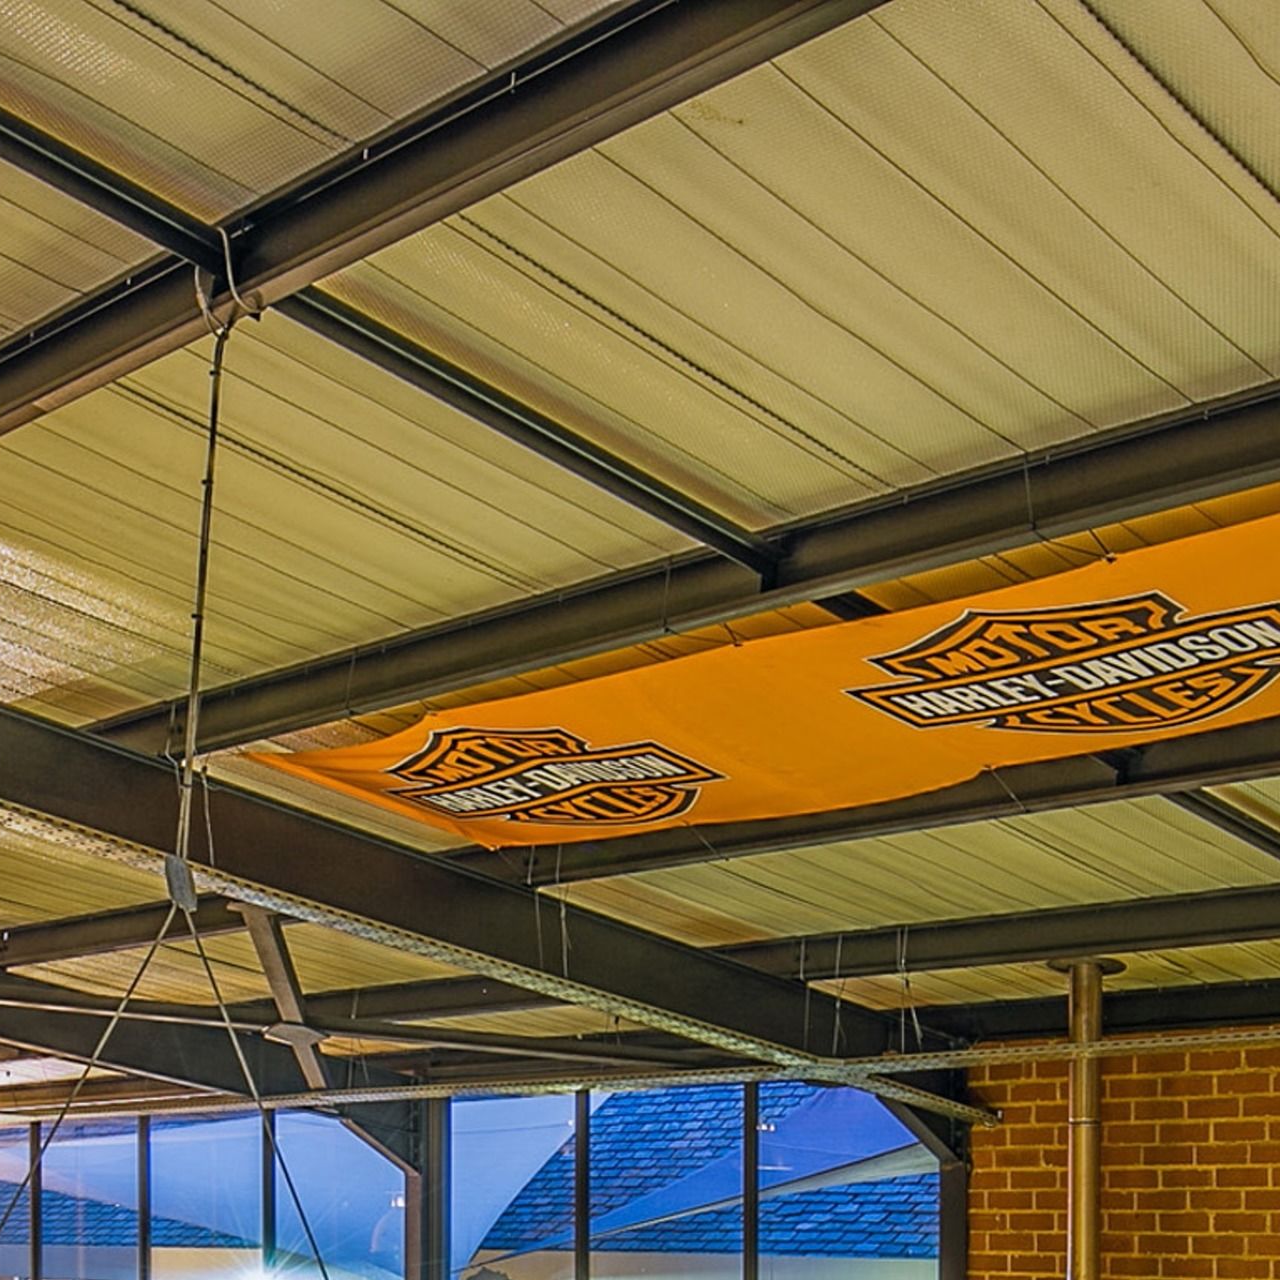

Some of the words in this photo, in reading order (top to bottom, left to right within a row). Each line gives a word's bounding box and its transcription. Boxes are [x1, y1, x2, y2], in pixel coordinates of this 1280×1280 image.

[930, 616, 1145, 678] MOTOR
[1030, 672, 1235, 726] CYCLES
[421, 754, 687, 812] HARLEY-DAVIDSON
[435, 736, 567, 784] MOTOR
[529, 786, 669, 820] CYCLES
